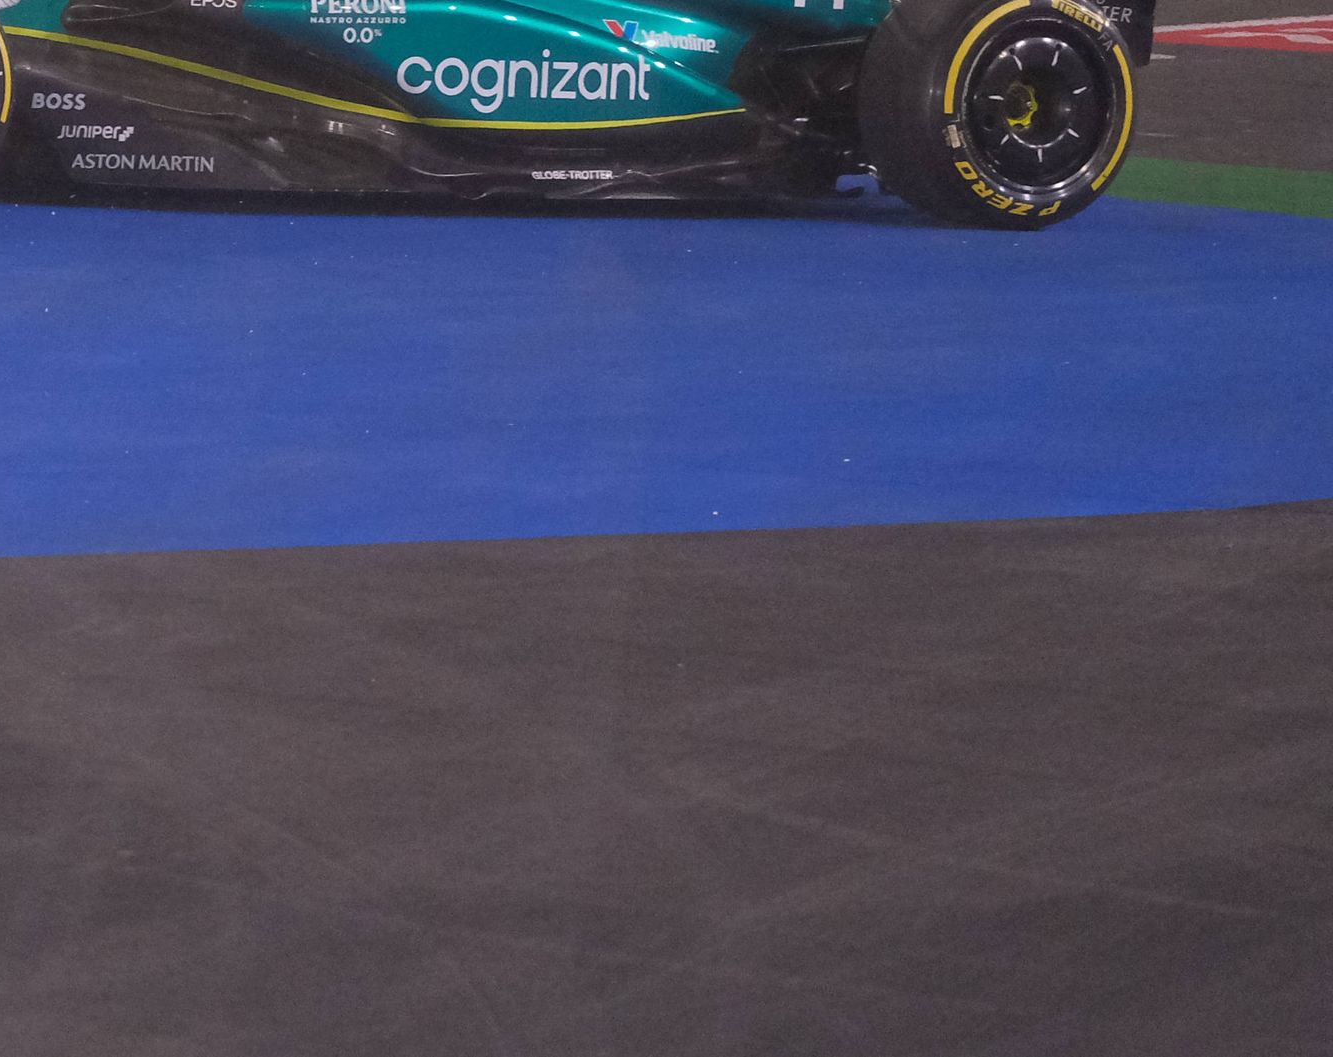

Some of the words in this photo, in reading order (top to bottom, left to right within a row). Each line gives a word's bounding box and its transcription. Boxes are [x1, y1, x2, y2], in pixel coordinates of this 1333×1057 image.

[309, 16, 353, 25] NASTRO
[356, 16, 407, 25] AZZURRO
[342, 26, 383, 44] 0.0%
[641, 29, 717, 53] Valvoline
[395, 48, 652, 114] cognizant
[31, 92, 87, 111] BOSS
[71, 152, 136, 170] ASTON
[138, 153, 215, 173] MARTIN
[532, 169, 615, 181] GLOBE-TROTTER
[954, 160, 1036, 217] ZERO
